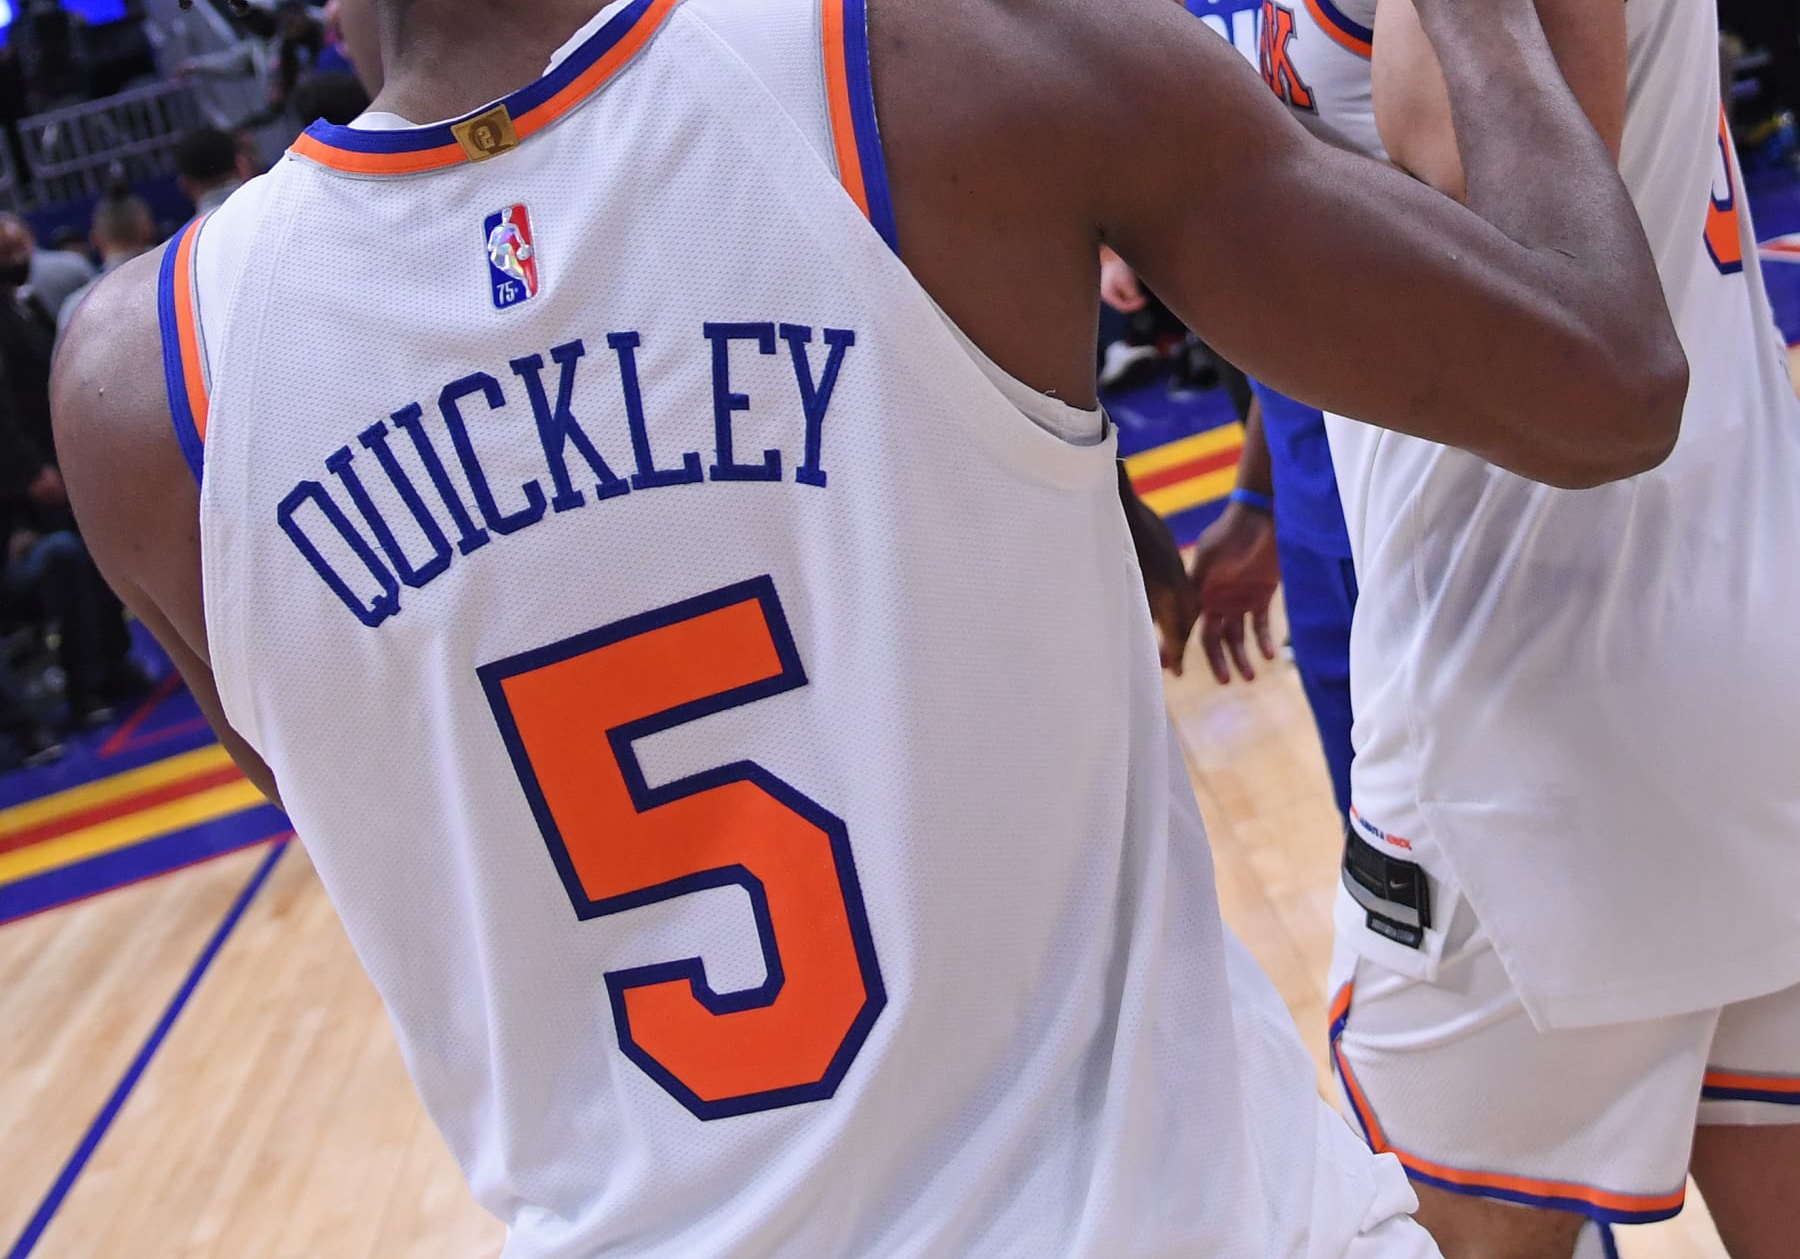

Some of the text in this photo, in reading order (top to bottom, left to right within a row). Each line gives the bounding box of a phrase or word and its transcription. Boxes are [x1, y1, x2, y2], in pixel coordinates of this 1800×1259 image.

[496, 280, 516, 305] 75
[277, 322, 855, 628] QUICKLEY
[476, 574, 888, 1121] 5
